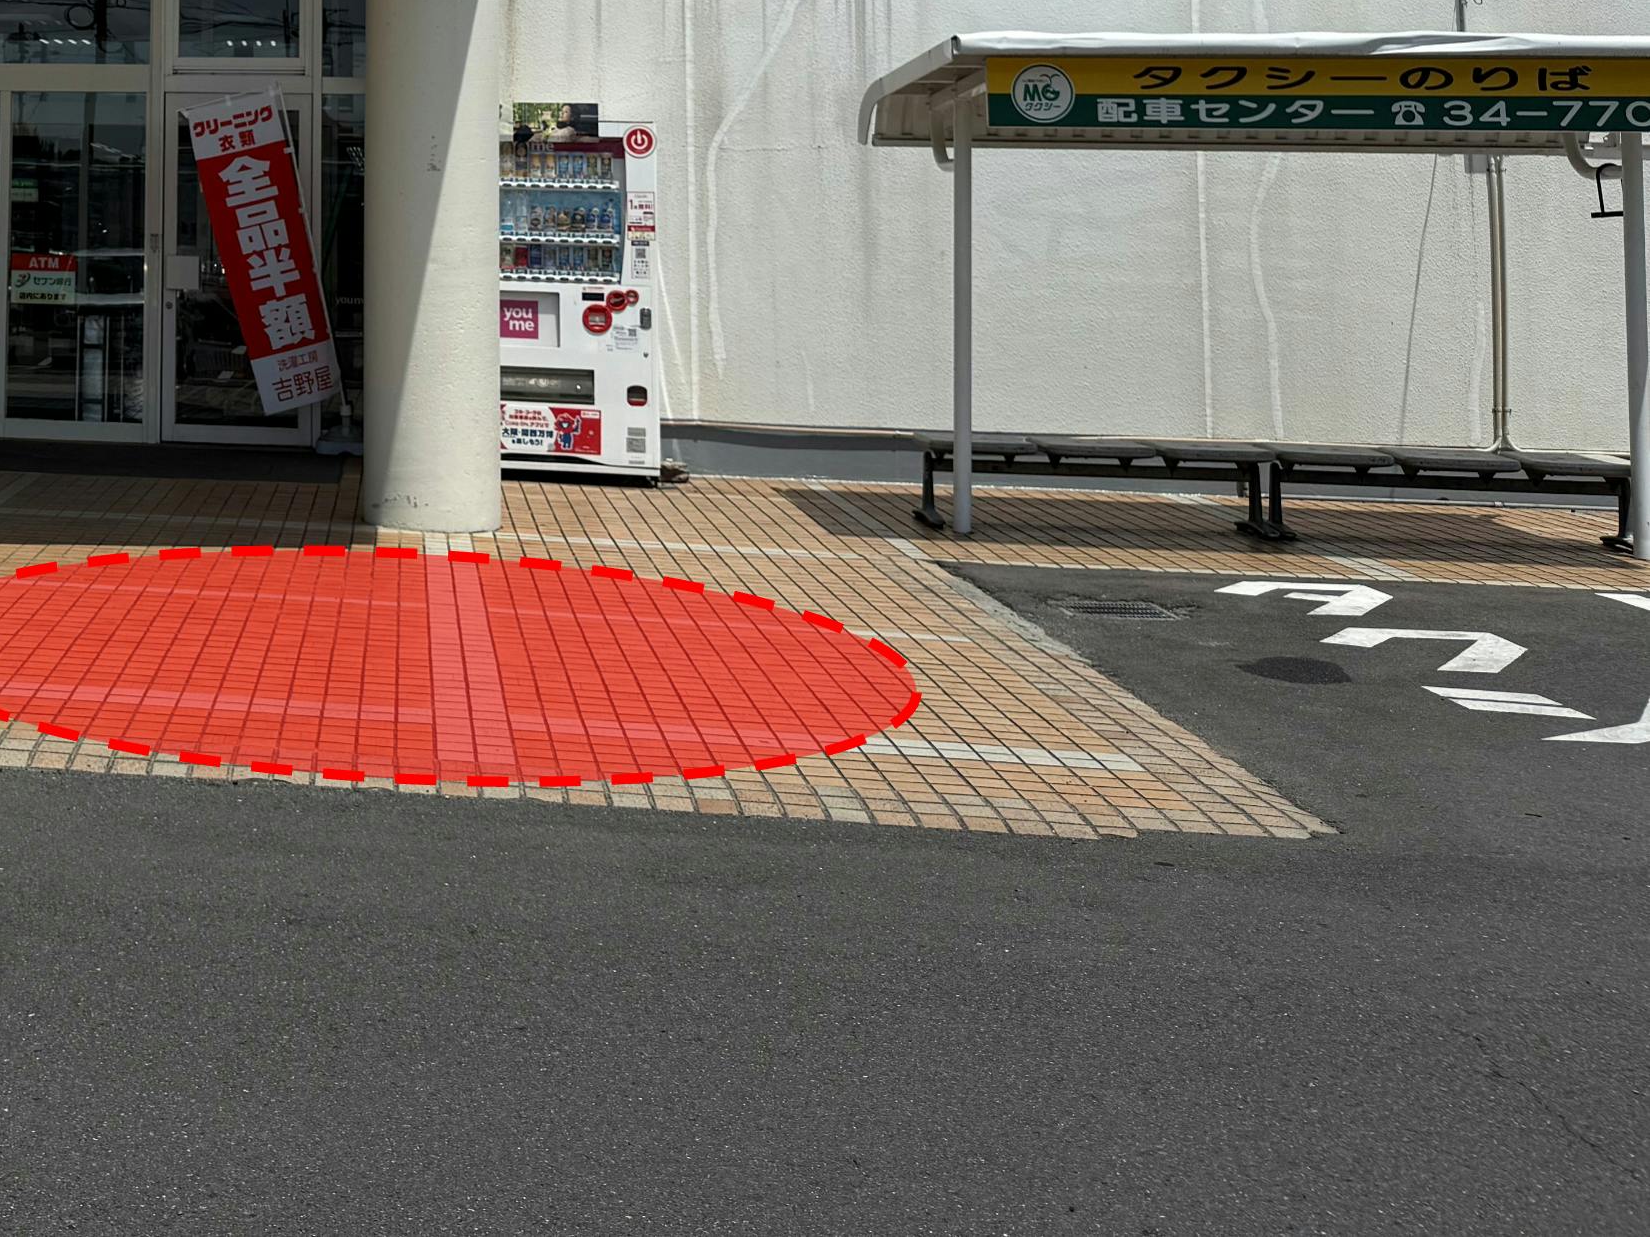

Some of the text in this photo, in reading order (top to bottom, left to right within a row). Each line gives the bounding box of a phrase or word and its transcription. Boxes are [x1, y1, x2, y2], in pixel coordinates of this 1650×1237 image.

[1133, 65, 1592, 91] タクシーのりば
[1024, 102, 1062, 112] タクシー
[1097, 98, 1375, 123] 配車センター
[193, 105, 273, 138] クリーニング
[218, 130, 256, 152] 衣類
[29, 257, 59, 268] ATM
[218, 155, 316, 351] 全品半額
[503, 307, 532, 321] you
[509, 320, 535, 332] me
[272, 365, 334, 403] 吉野屋
